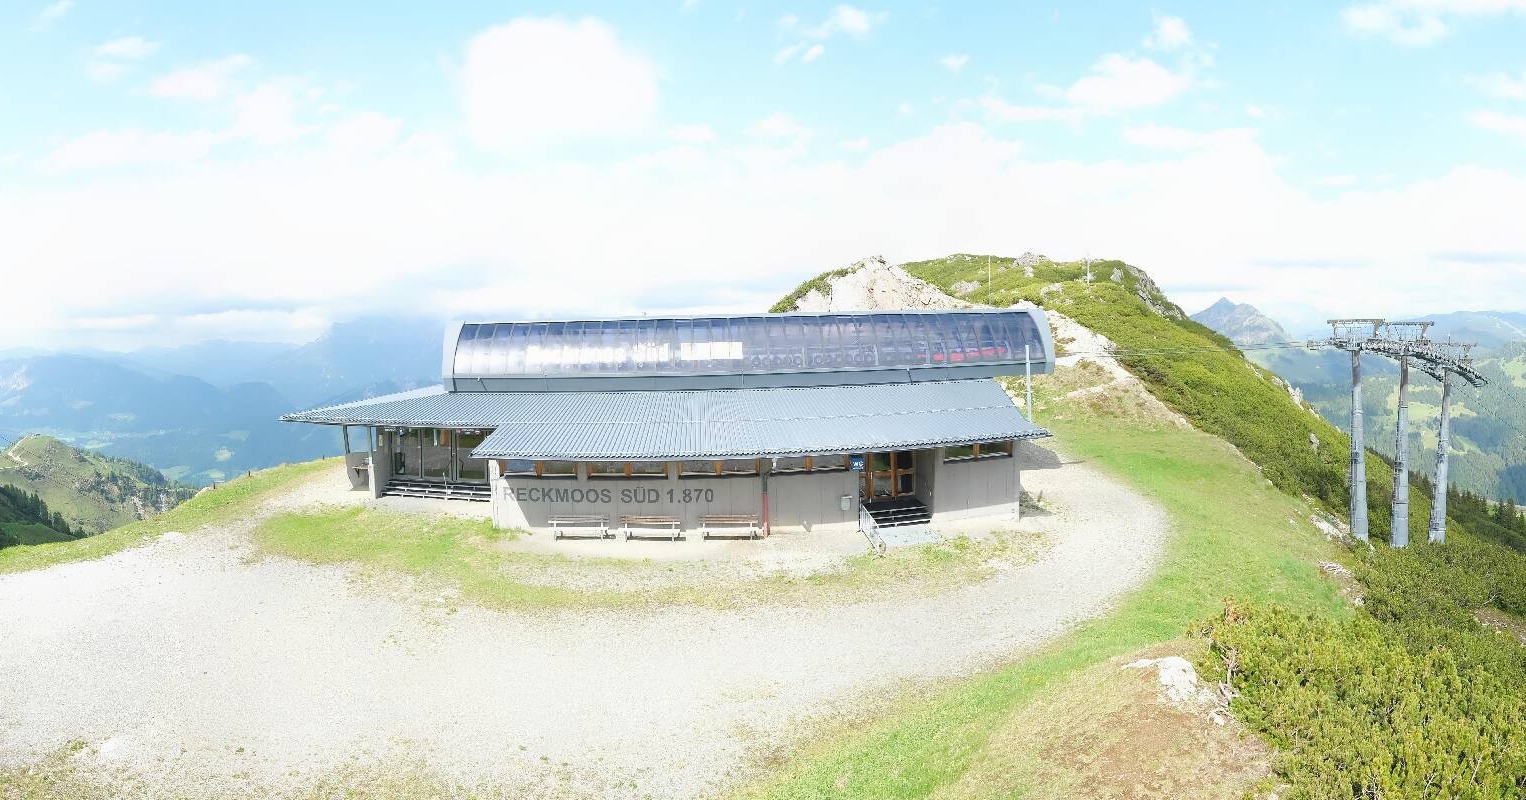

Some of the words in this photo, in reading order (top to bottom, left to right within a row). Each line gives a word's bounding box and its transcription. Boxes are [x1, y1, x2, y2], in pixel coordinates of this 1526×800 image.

[503, 487, 612, 504] RECKMOOS
[621, 486, 660, 504] SÜD
[666, 488, 714, 504] 1.870
